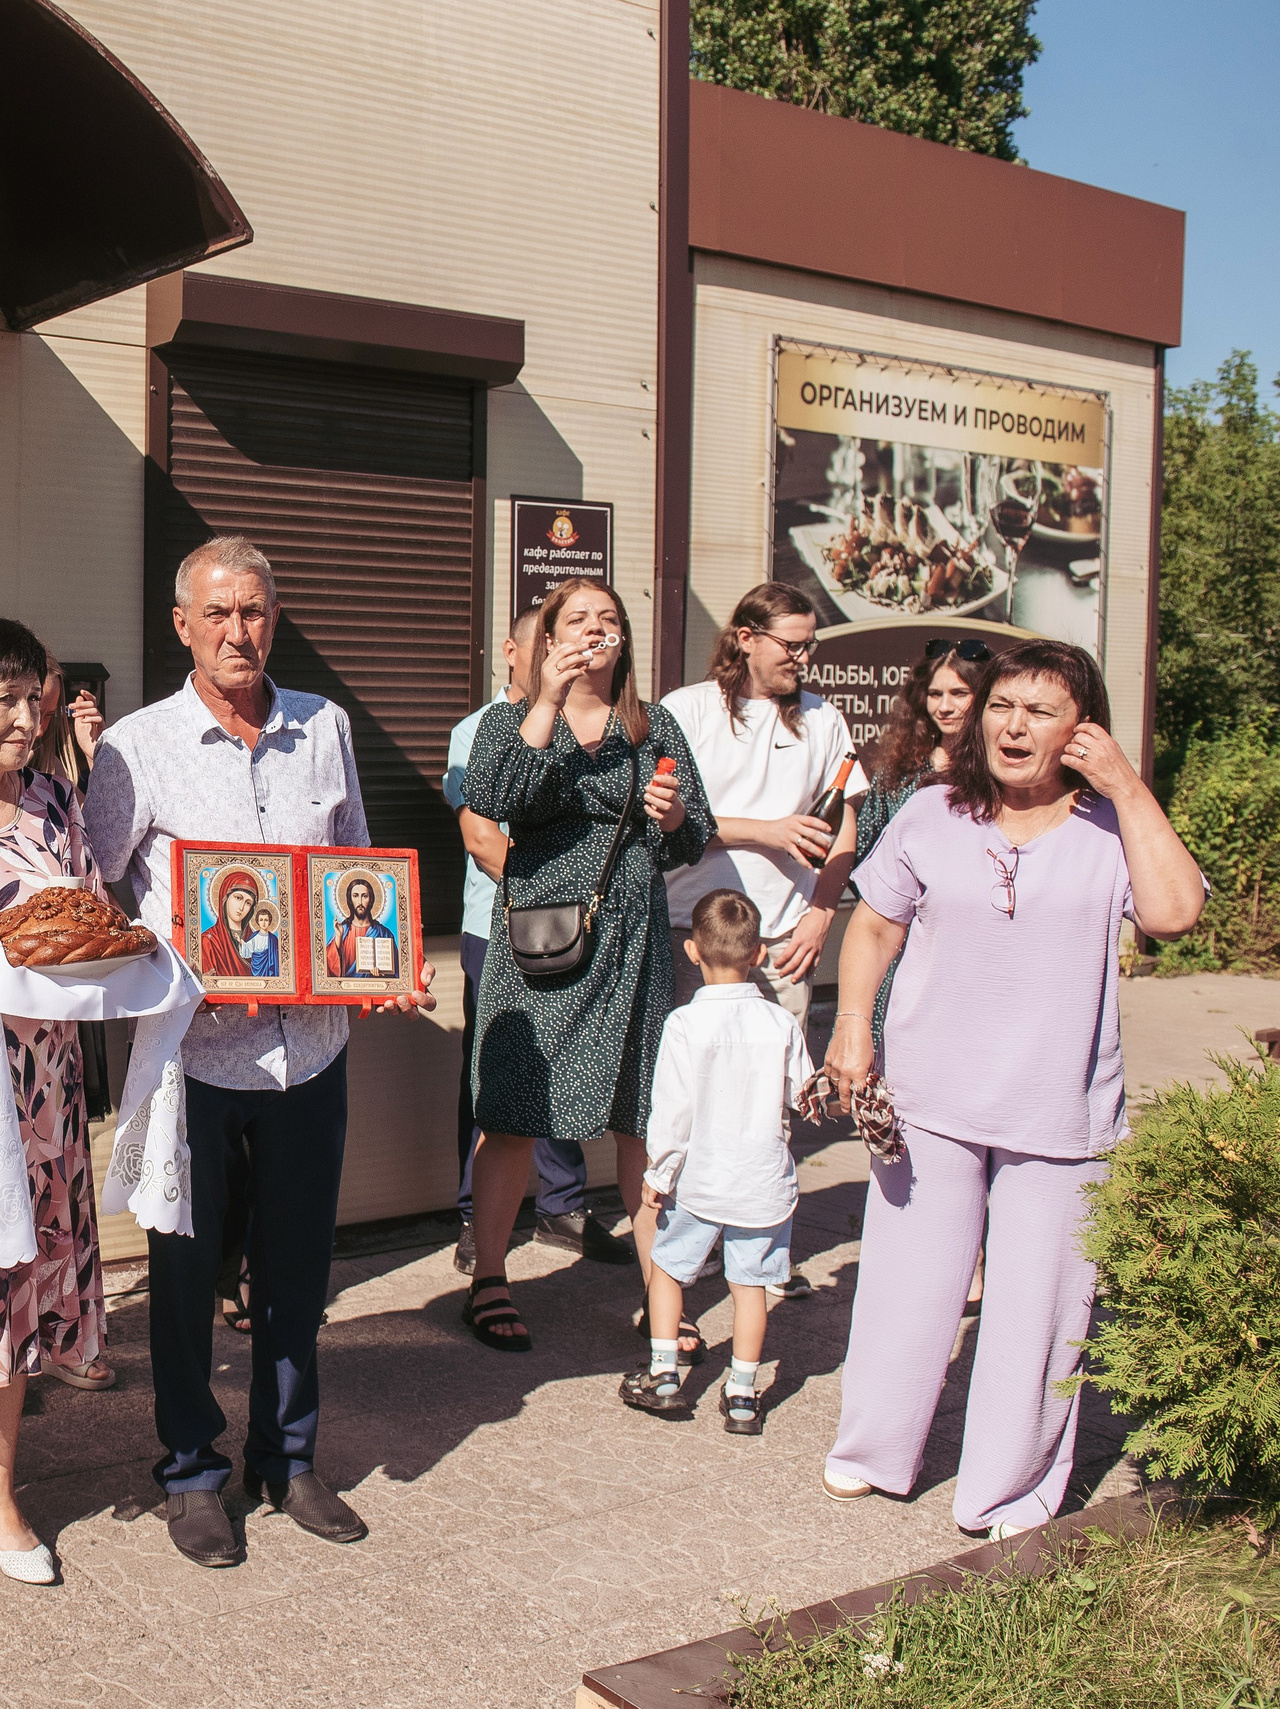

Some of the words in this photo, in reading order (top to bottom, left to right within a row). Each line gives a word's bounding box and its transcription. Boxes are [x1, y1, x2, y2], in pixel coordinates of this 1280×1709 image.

[800, 381, 947, 424] ОРГАНИЗУЕМ
[954, 404, 967, 426] И
[974, 407, 1086, 444] ПРОВОДИМ
[523, 546, 548, 560] кафе
[549, 548, 591, 560] работает
[591, 551, 603, 560] по
[522, 562, 604, 577] предварительным
[545, 581, 563, 590] зак
[798, 663, 879, 689] ВАДЬБЫ,
